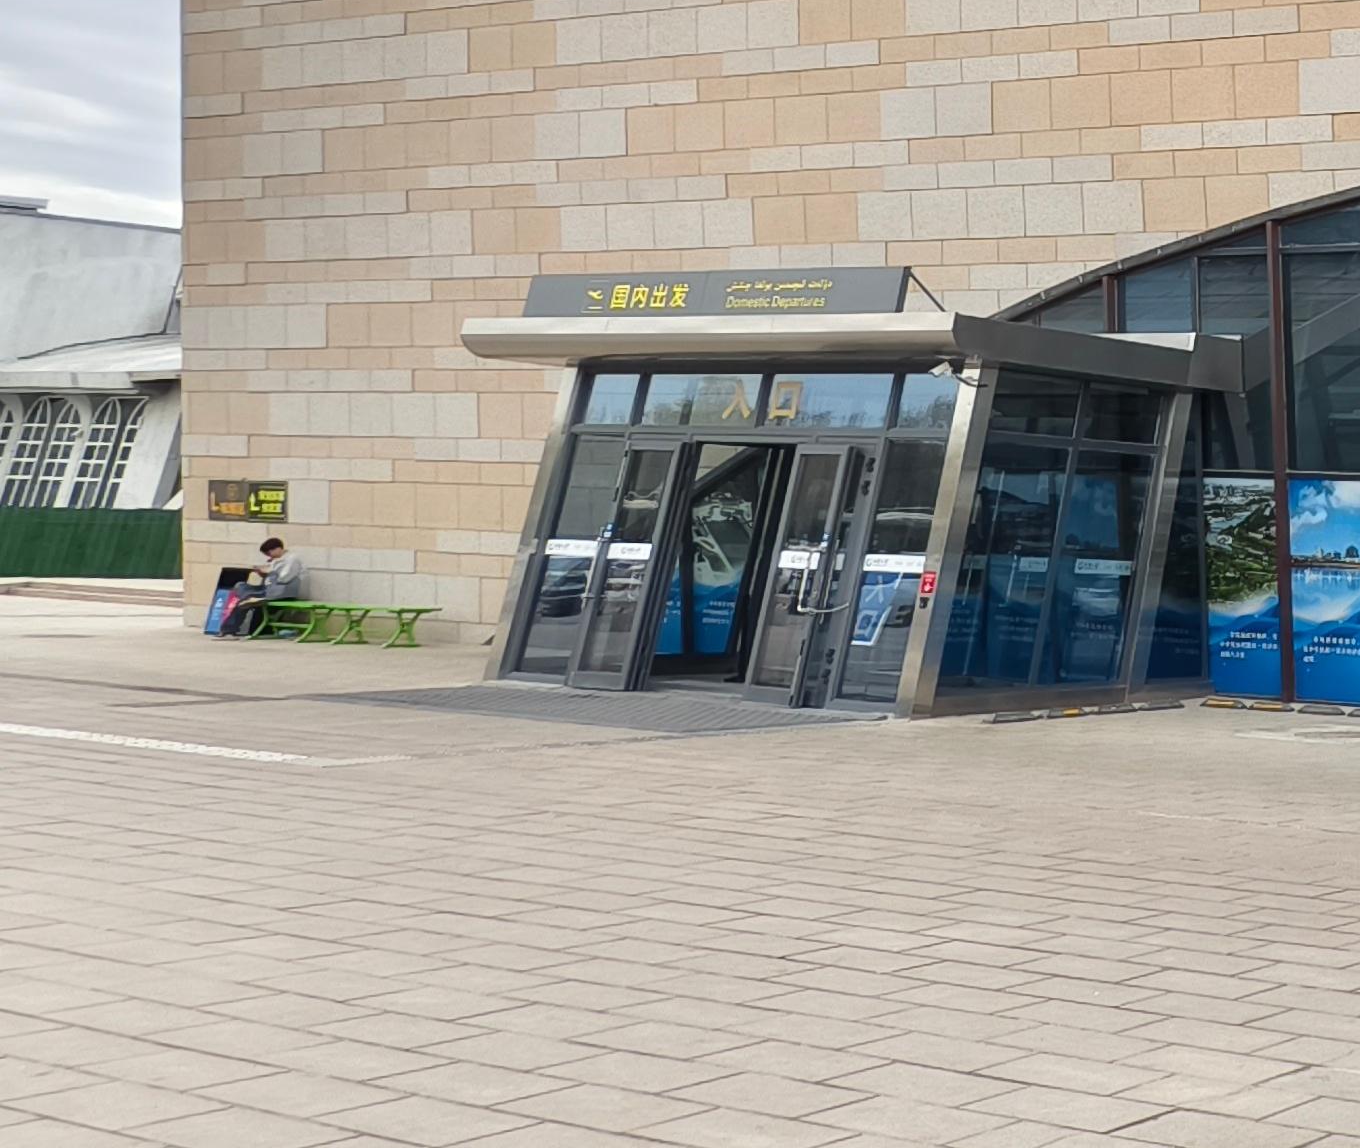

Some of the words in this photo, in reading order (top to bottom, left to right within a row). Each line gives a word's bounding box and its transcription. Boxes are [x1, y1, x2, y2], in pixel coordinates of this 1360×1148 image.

[608, 284, 689, 310] 国内出发
[725, 295, 770, 308] Domestic
[771, 295, 826, 310] Departures
[721, 377, 803, 421] 入口
